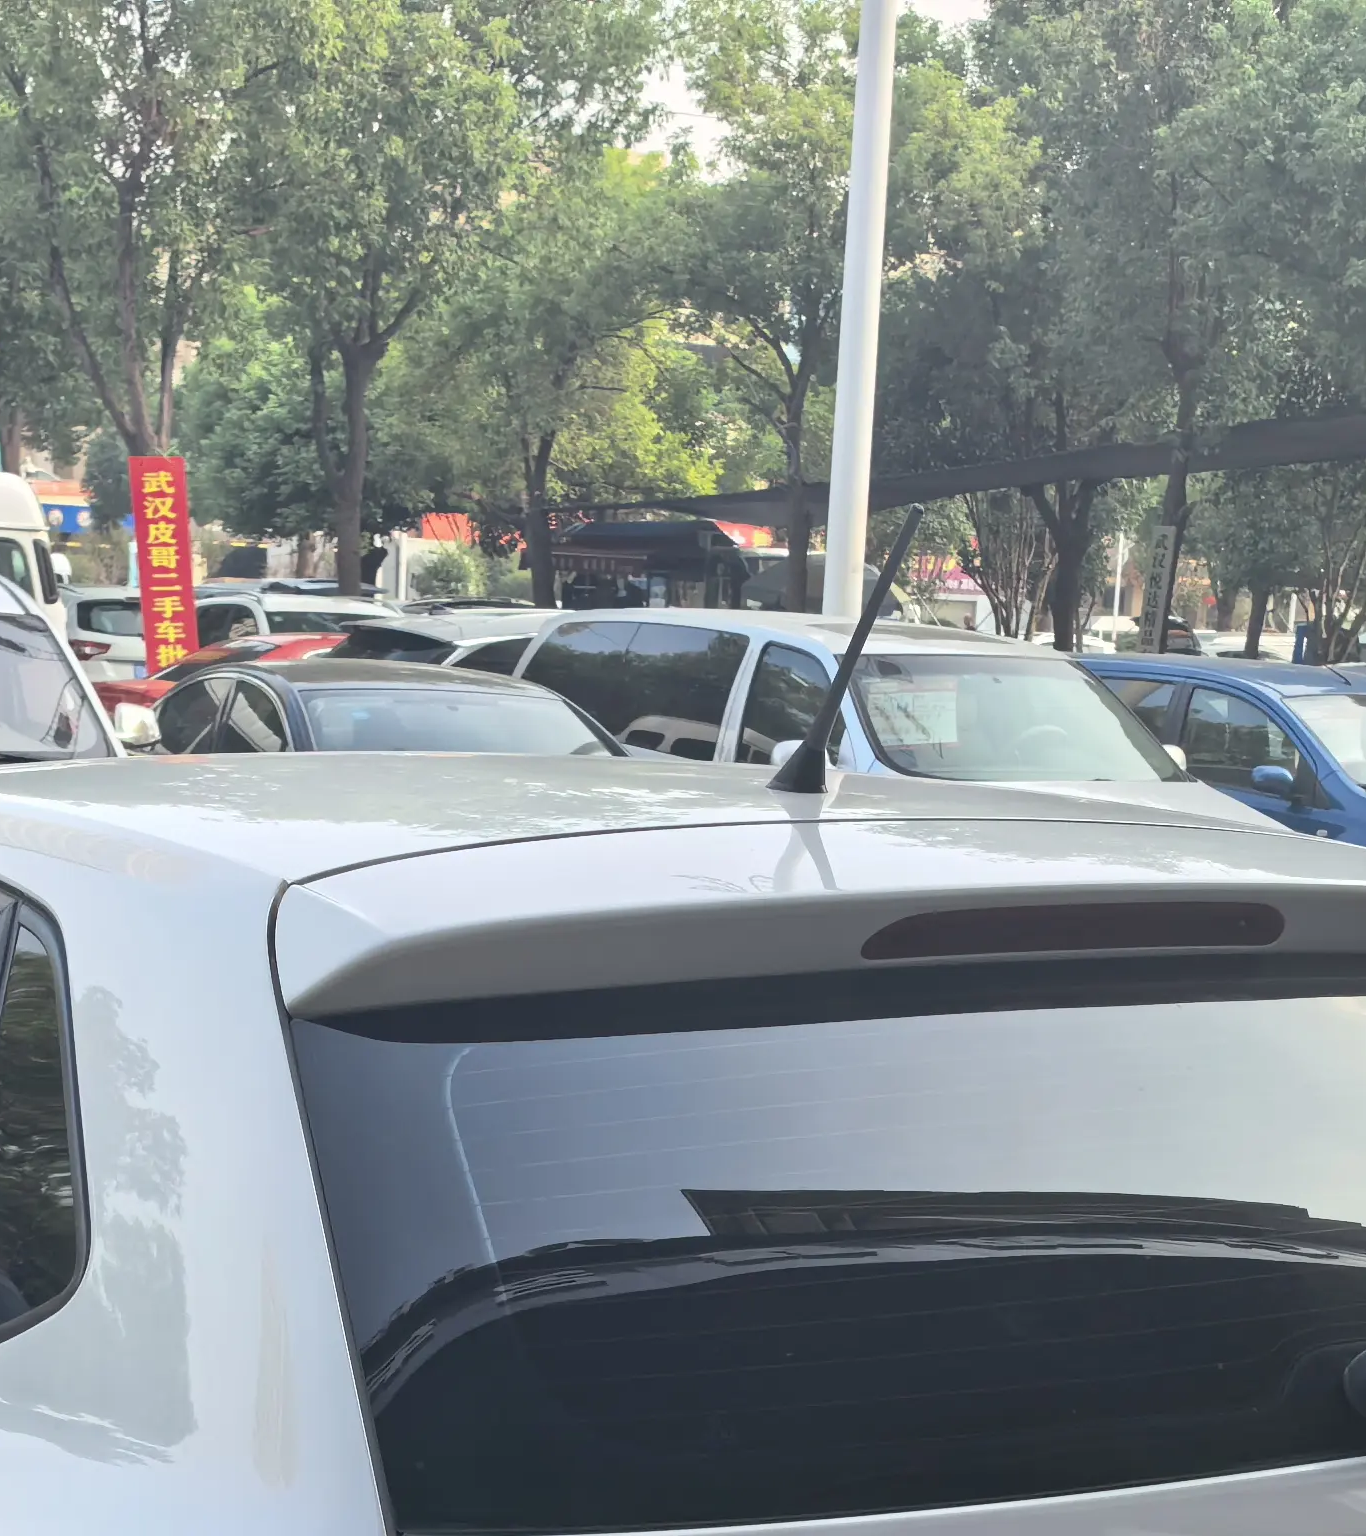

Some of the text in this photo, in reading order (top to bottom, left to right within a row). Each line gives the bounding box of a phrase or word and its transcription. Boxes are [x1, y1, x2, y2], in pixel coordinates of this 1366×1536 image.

[140, 470, 189, 669] 武汉皮哥二手车批
[1140, 533, 1169, 653] 武汉悦达精品
